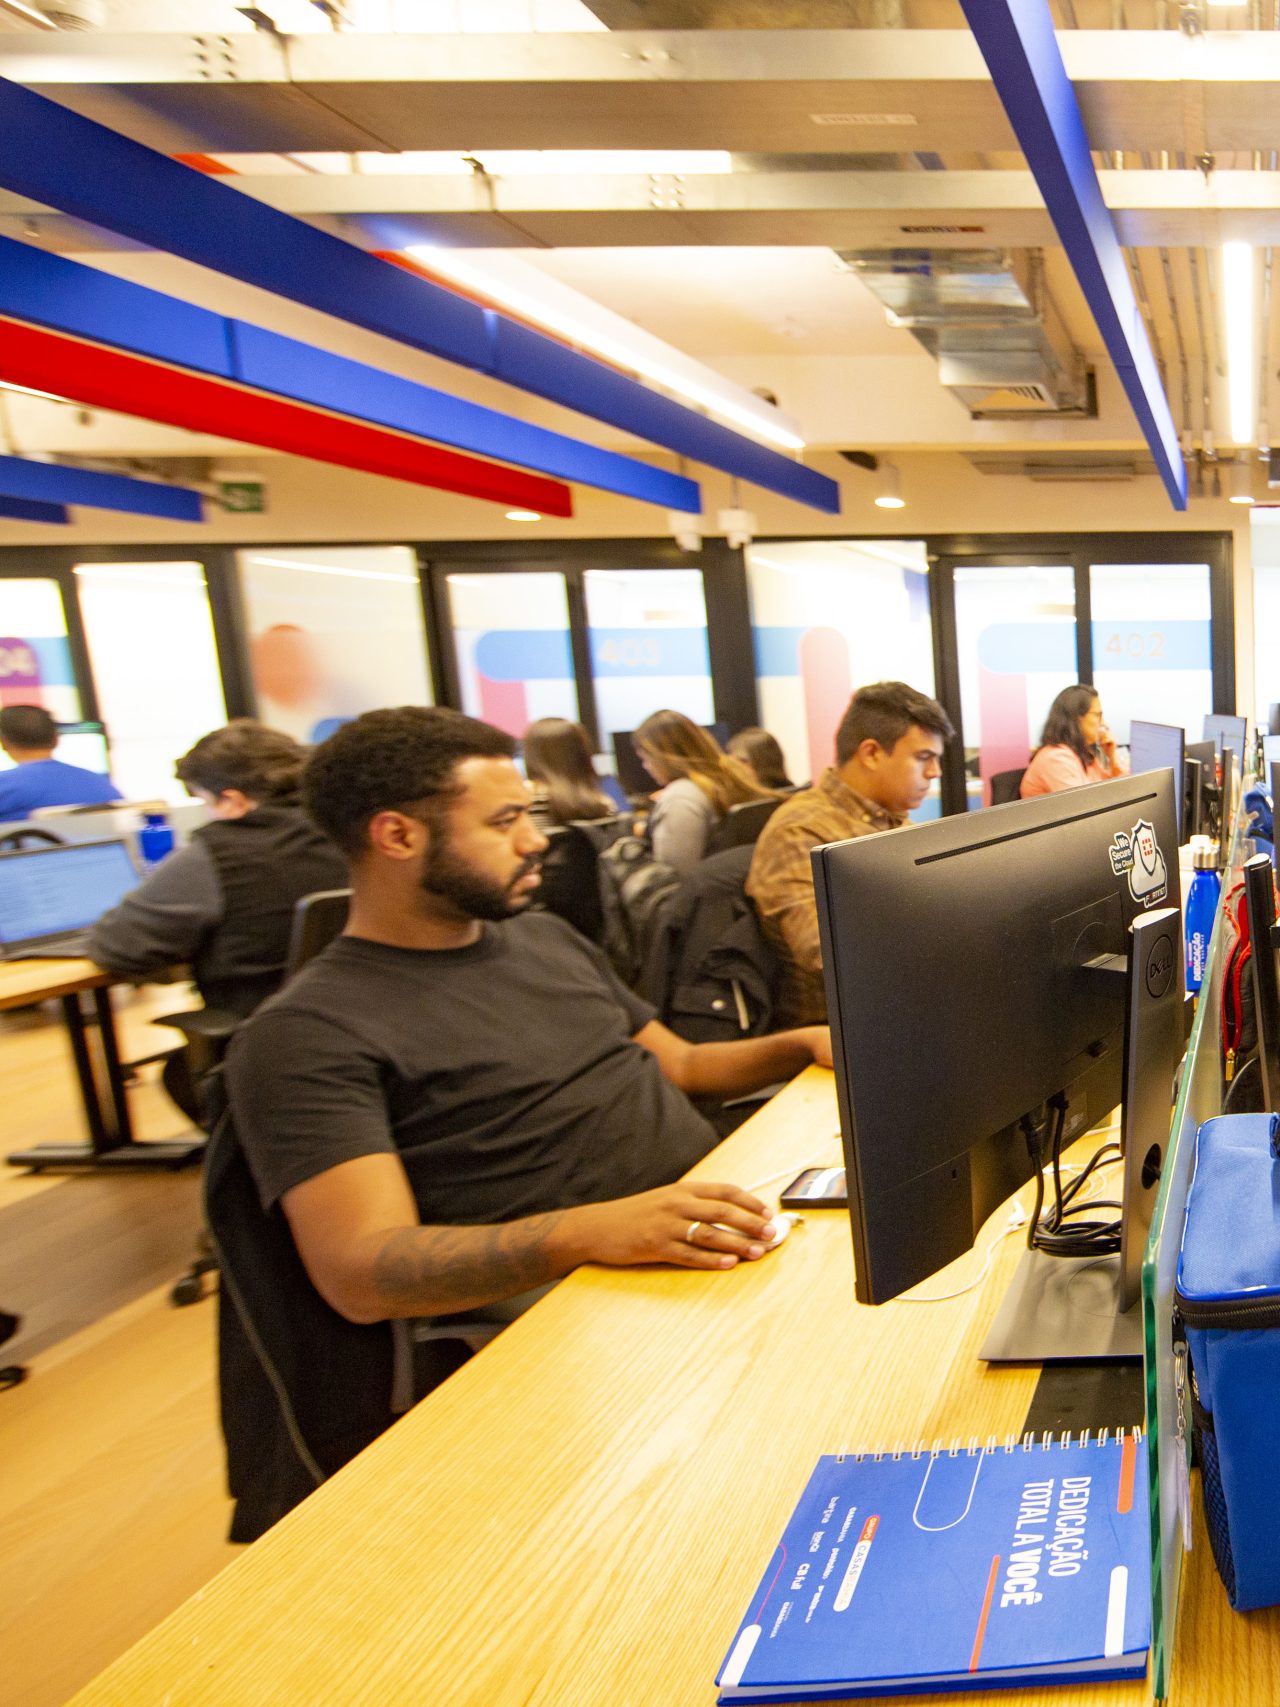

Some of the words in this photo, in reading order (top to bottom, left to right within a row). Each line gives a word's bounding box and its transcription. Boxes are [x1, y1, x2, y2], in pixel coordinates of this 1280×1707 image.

[1104, 632, 1165, 657] 402
[1112, 849, 1132, 861] Secure
[1117, 837, 1129, 848] We
[1150, 955, 1172, 979] DELL
[1015, 1478, 1055, 1530] TOTAL
[1045, 1476, 1092, 1577] DEDICAÇÃO
[1012, 1533, 1045, 1547] A
[849, 1544, 867, 1576] CASAS
[1000, 1547, 1043, 1608] VOCÊ
